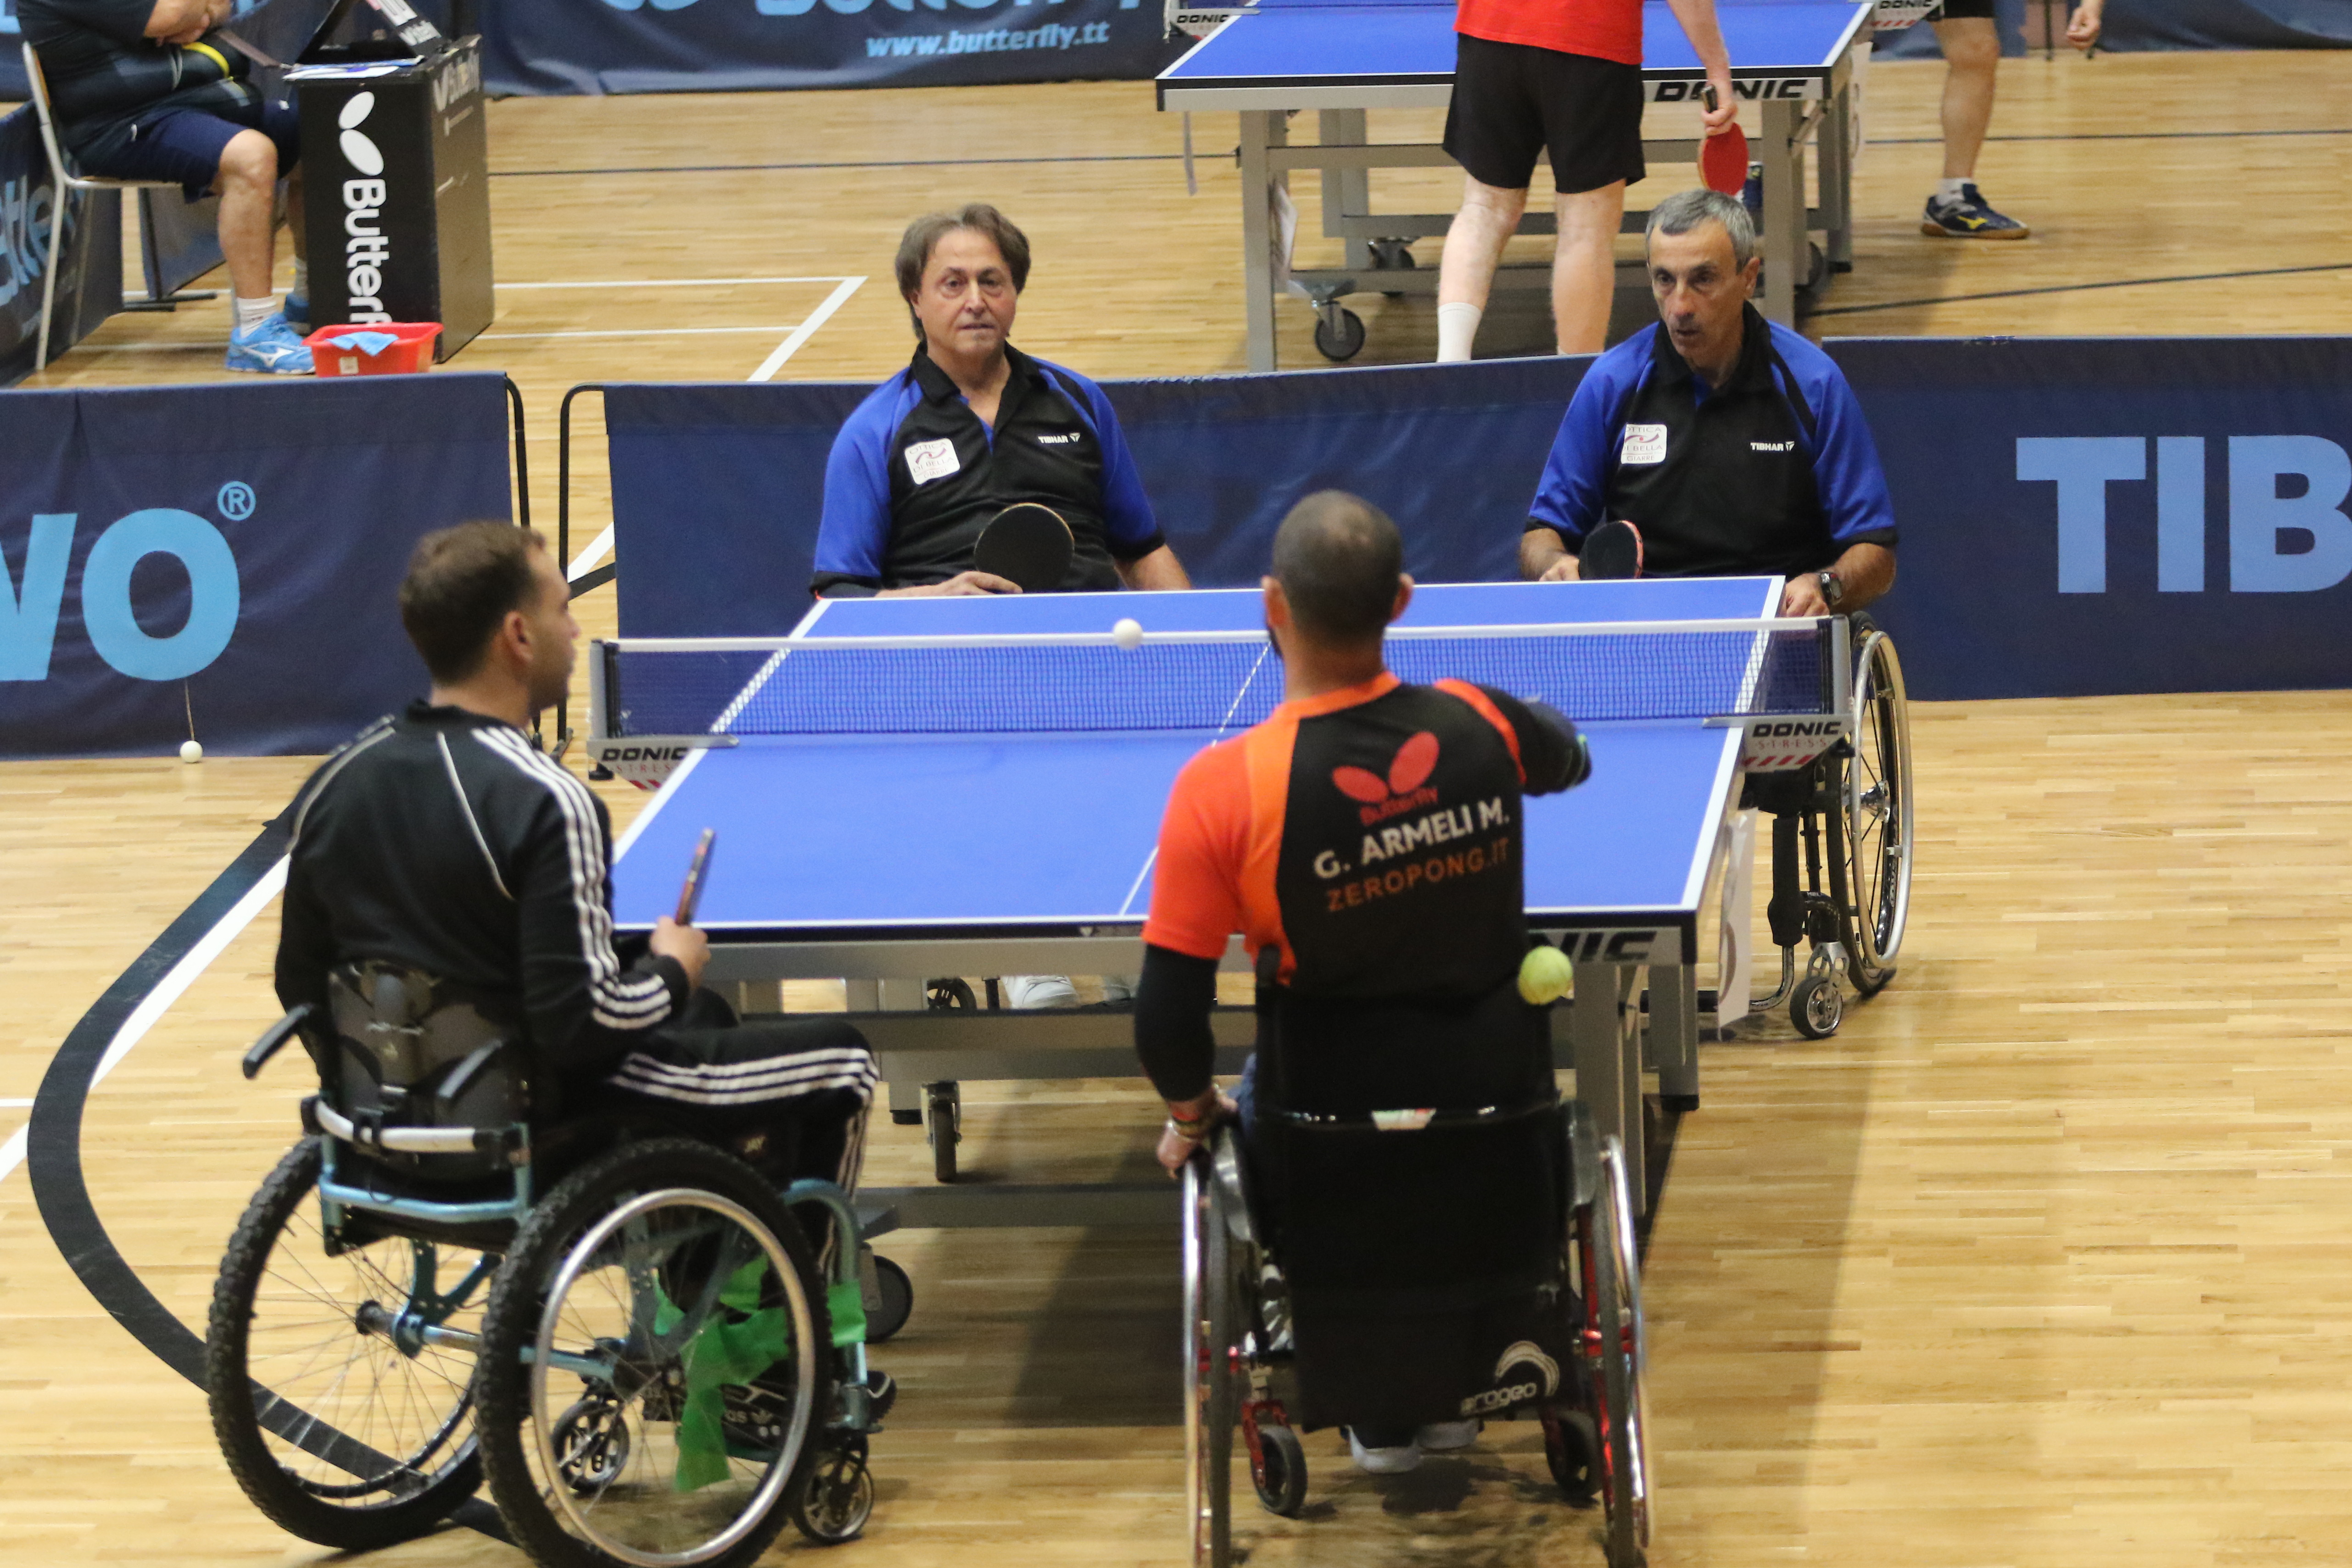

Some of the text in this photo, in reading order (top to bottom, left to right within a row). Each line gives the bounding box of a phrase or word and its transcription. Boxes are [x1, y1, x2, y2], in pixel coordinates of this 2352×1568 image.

[1177, 15, 1229, 23] DONIC
[866, 20, 1110, 57] www.butterfly.tt
[1654, 79, 1808, 102] DNIC
[1038, 435, 1069, 444] TIBHAR
[1750, 442, 1784, 452] TIBHAR
[2016, 435, 2352, 593] TIB
[1753, 722, 1841, 737] DONIC
[602, 748, 687, 761] DONIC
[1313, 796, 1510, 879] G. ARMELI M.
[1327, 837, 1509, 912] ZEROPONG.IT
